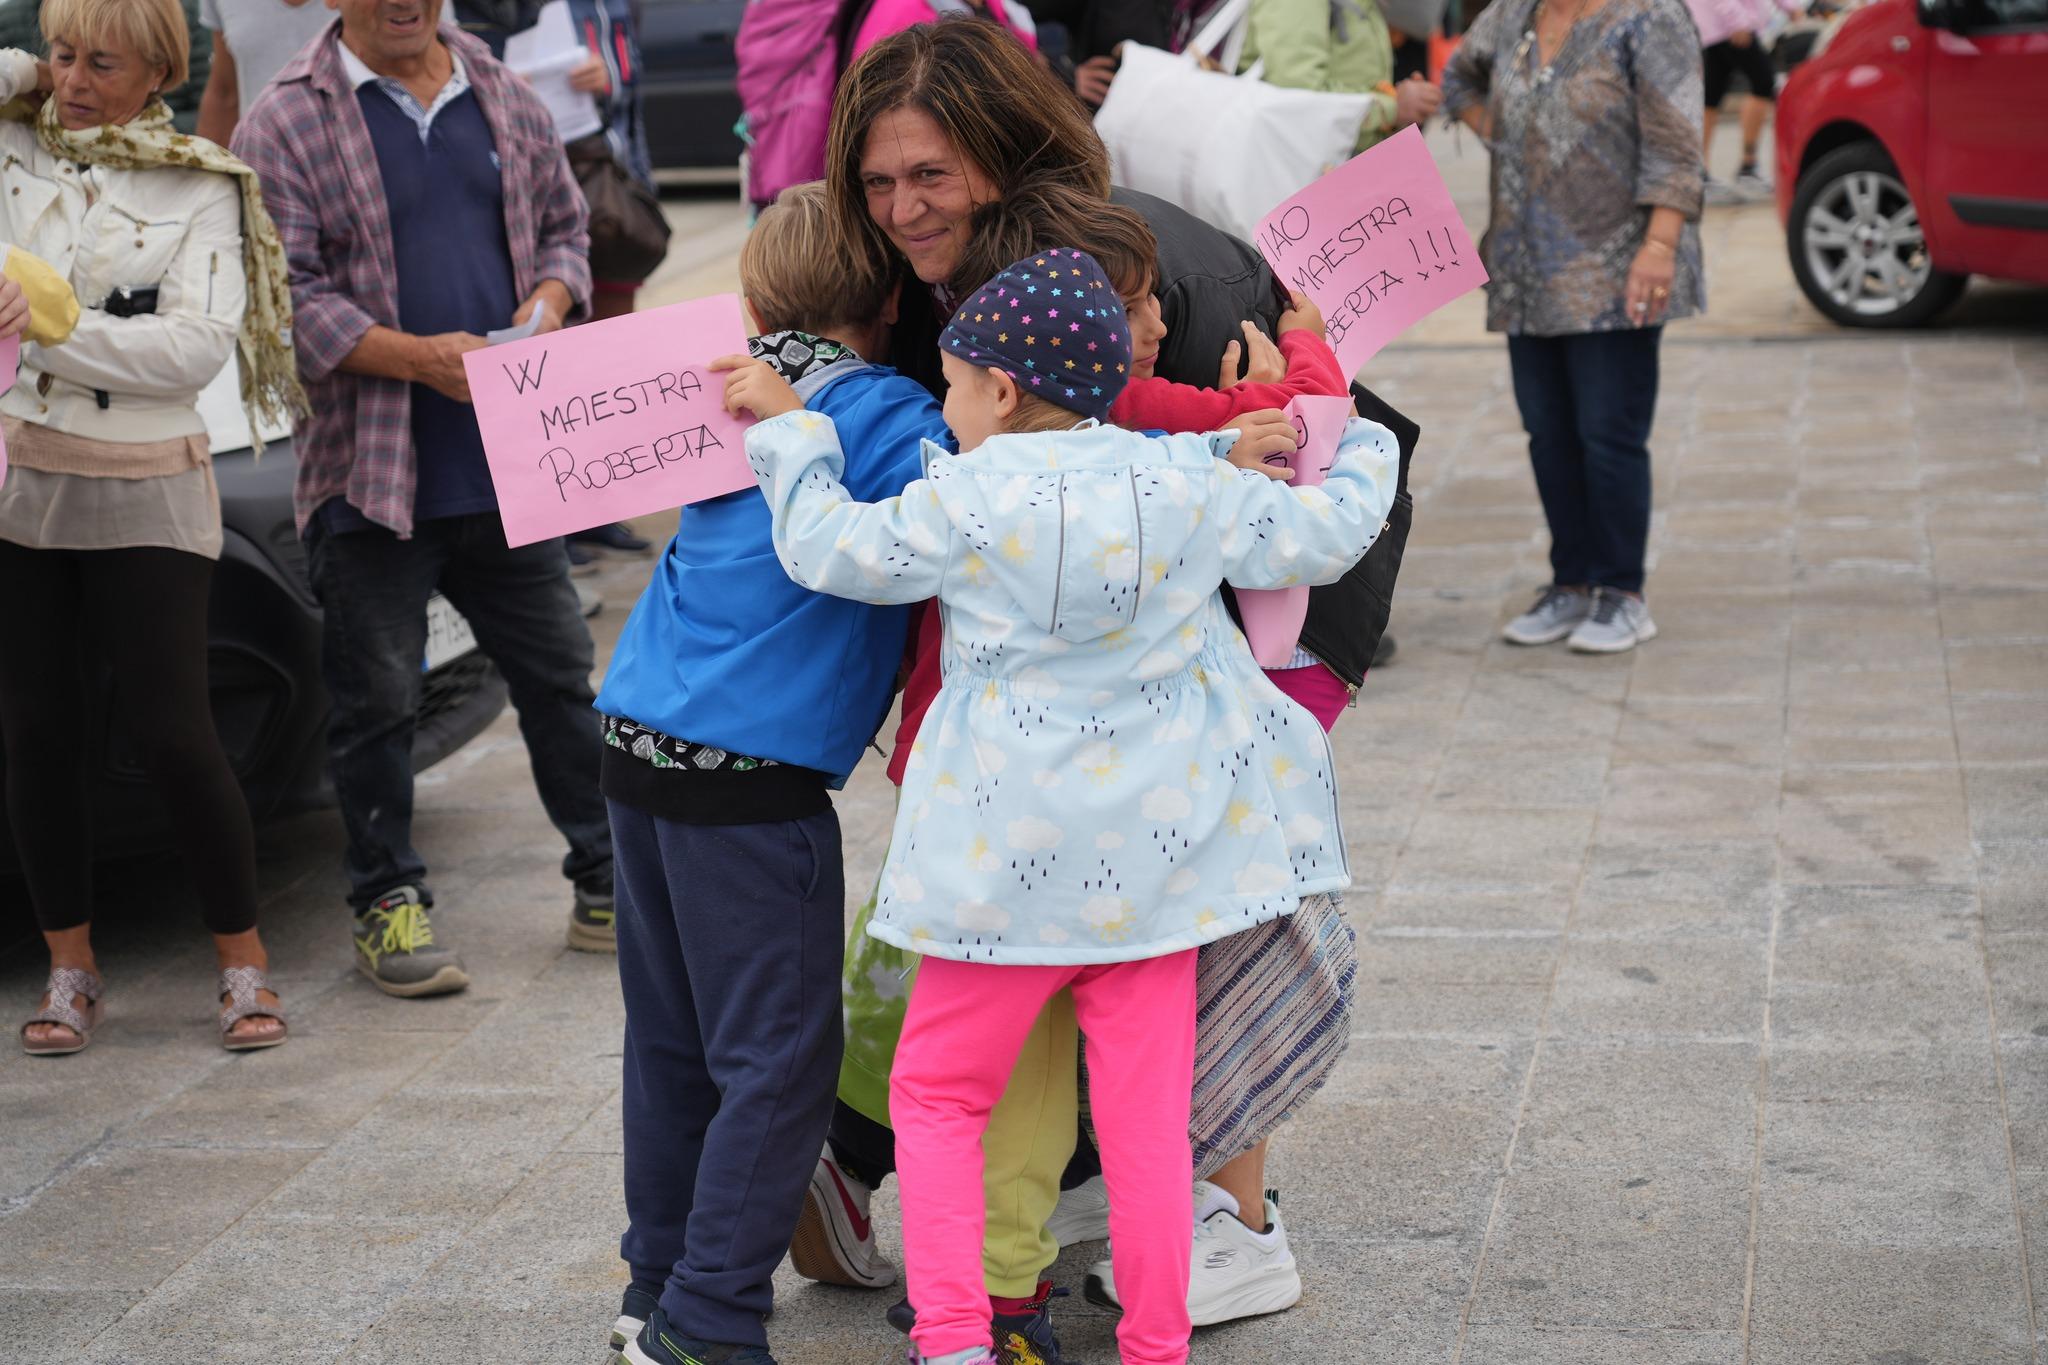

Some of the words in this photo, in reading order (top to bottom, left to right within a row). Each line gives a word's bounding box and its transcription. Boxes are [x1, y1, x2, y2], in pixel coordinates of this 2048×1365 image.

[1257, 205, 1310, 263] IAO
[1292, 197, 1412, 297] MAESTRA
[502, 350, 547, 395] W
[540, 370, 702, 441] MAESTRA
[538, 423, 725, 502] ROBERTA
